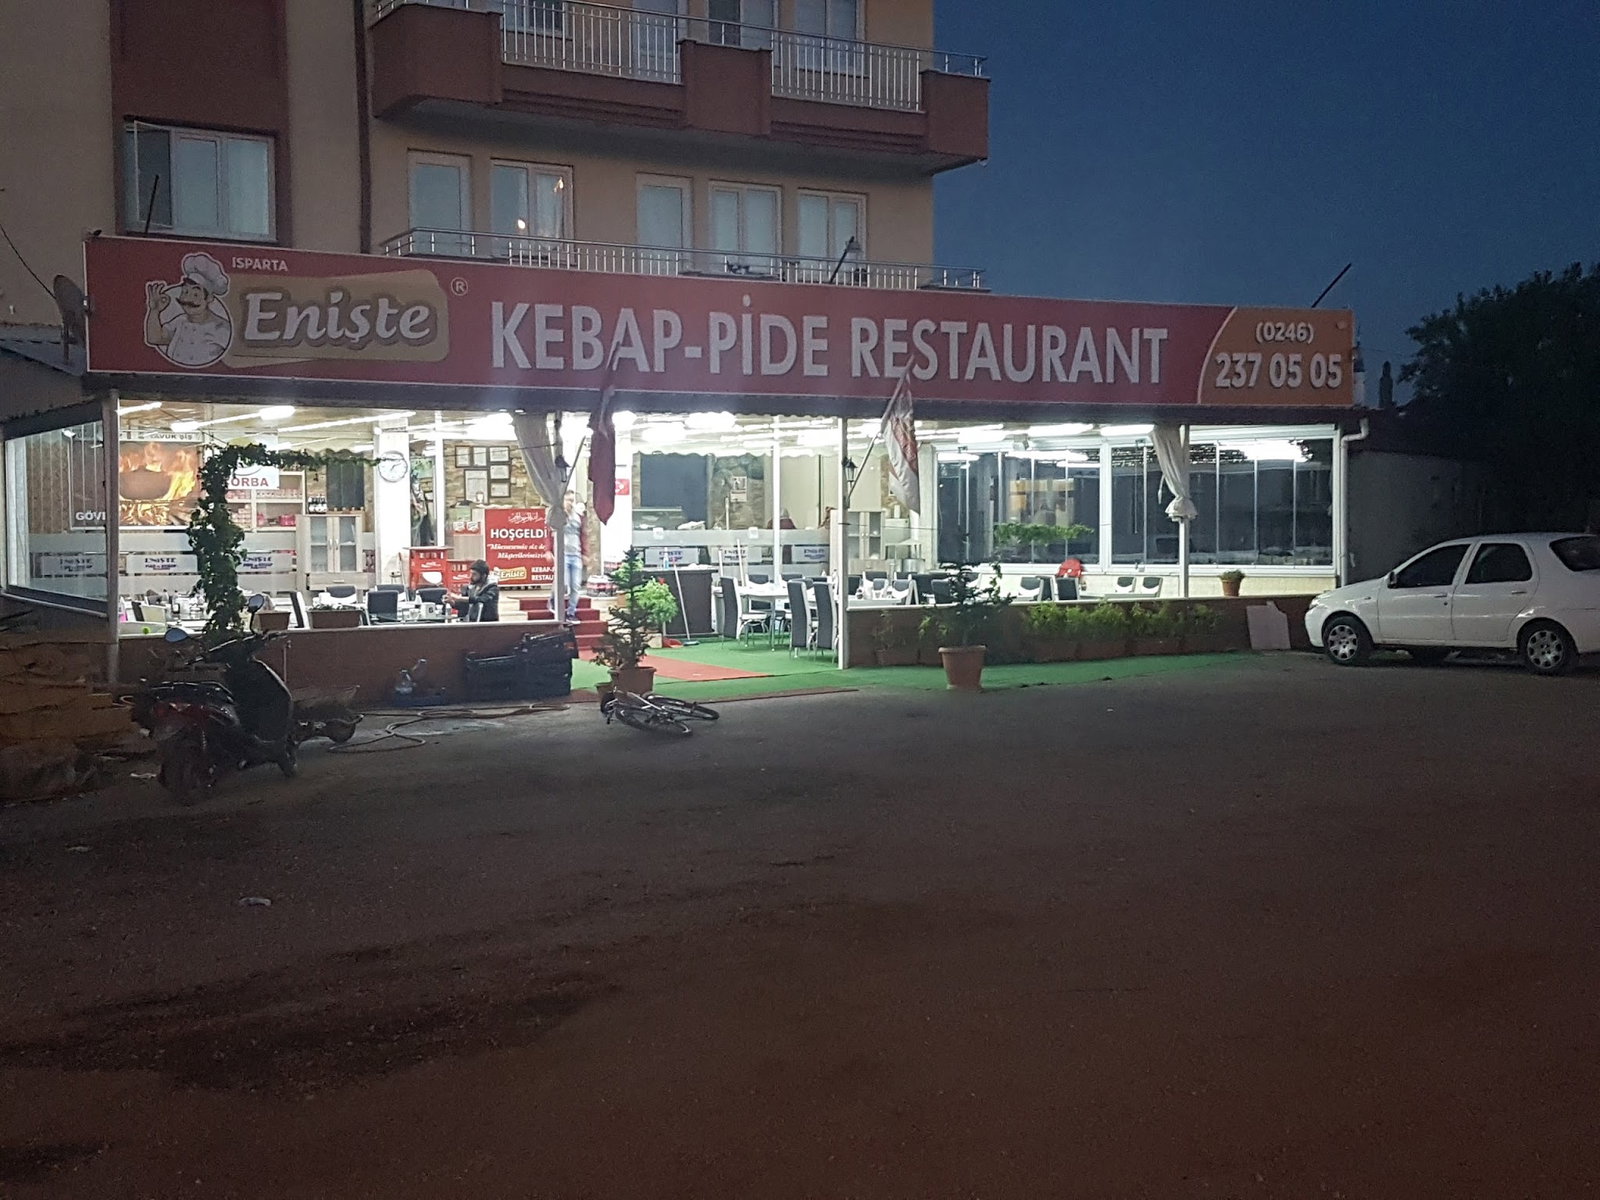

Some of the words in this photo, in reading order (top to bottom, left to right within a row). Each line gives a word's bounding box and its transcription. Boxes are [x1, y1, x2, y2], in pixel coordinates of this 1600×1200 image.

[232, 257, 288, 271] ISPARTA
[244, 291, 431, 343] Enişte
[491, 294, 829, 376] KEBAP-PİDE
[851, 317, 1168, 383] RESTAURANT
[1255, 322, 1314, 344] (0246)
[1215, 352, 1262, 388] 237
[1269, 352, 1302, 388] 05
[1310, 352, 1342, 388] 05
[231, 477, 269, 487] ORBA
[490, 526, 548, 541] HOŞGELDİ
